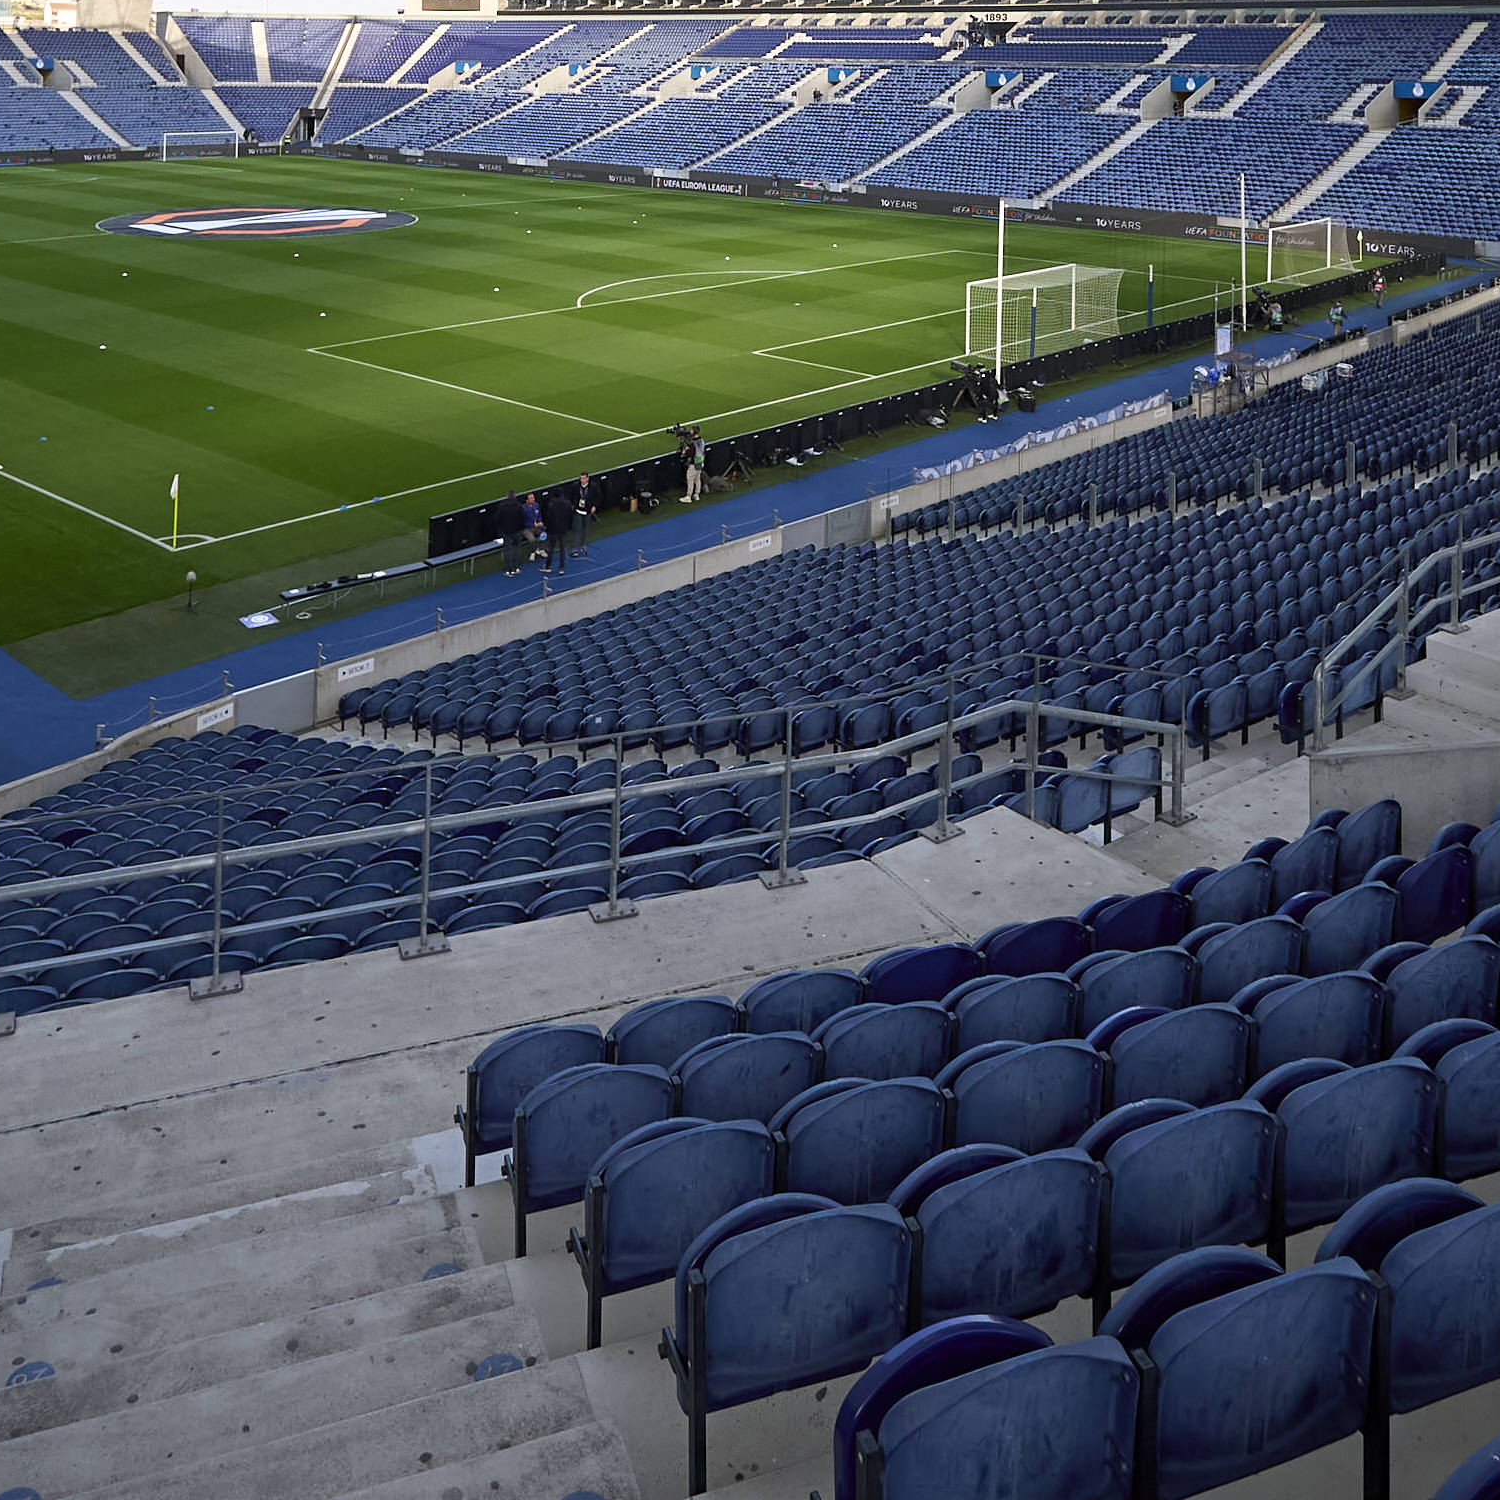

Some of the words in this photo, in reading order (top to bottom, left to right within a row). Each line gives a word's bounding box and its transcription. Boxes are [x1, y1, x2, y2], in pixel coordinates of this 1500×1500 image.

[985, 13, 1008, 21] 1893
[663, 179, 680, 188] UEFA
[681, 181, 707, 191] EUROPA
[708, 183, 735, 194] LEAGUE
[953, 205, 970, 214] UEFA
[1185, 227, 1207, 236] UEFA
